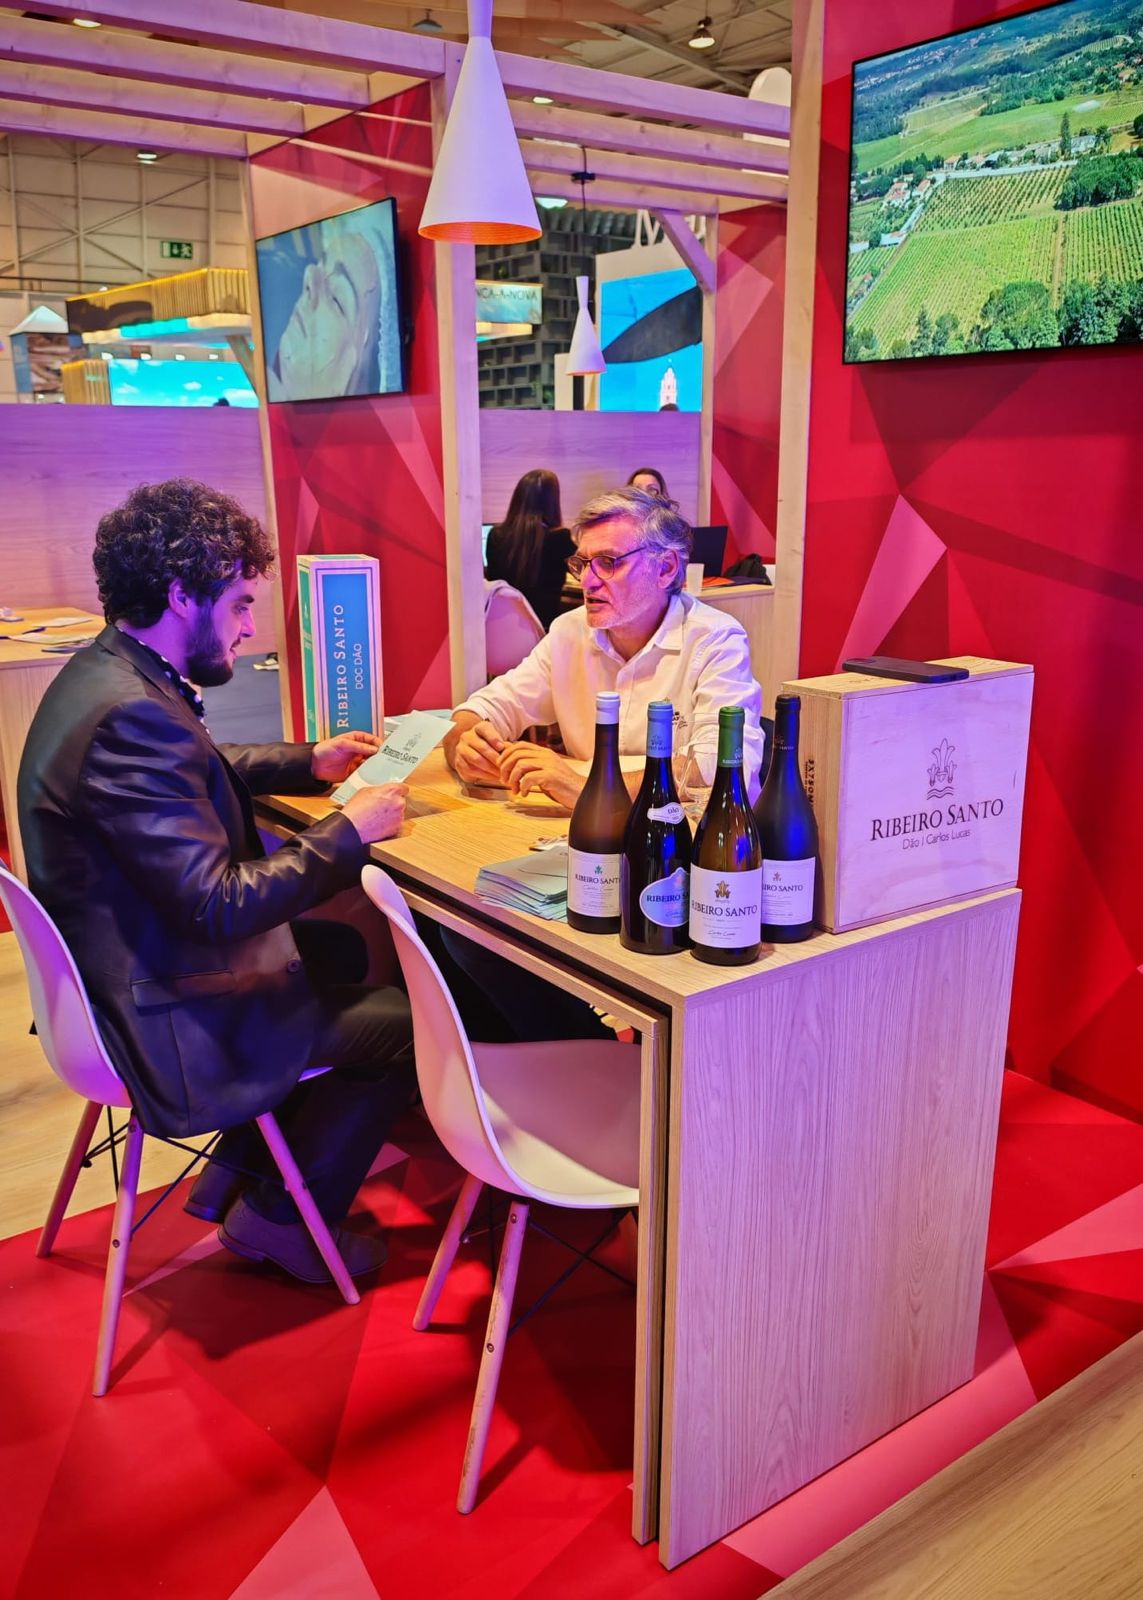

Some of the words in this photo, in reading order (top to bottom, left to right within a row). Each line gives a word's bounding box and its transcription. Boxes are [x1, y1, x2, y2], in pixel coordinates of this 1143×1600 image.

[333, 604, 346, 660] SANTO
[354, 668, 364, 690] DOC
[336, 665, 350, 728] RIBEIRO
[870, 809, 943, 841] RIBEIRO
[946, 798, 1004, 826] SANTO
[902, 837, 919, 850] Dão
[926, 832, 949, 845] Carlos
[951, 829, 972, 840] Lucas
[575, 873, 599, 884] RIBEIRO
[778, 884, 804, 892] SANTO
[646, 894, 681, 903] RIBEIRO
[691, 899, 723, 917] RIBEIRO
[725, 904, 758, 917] SANTO
